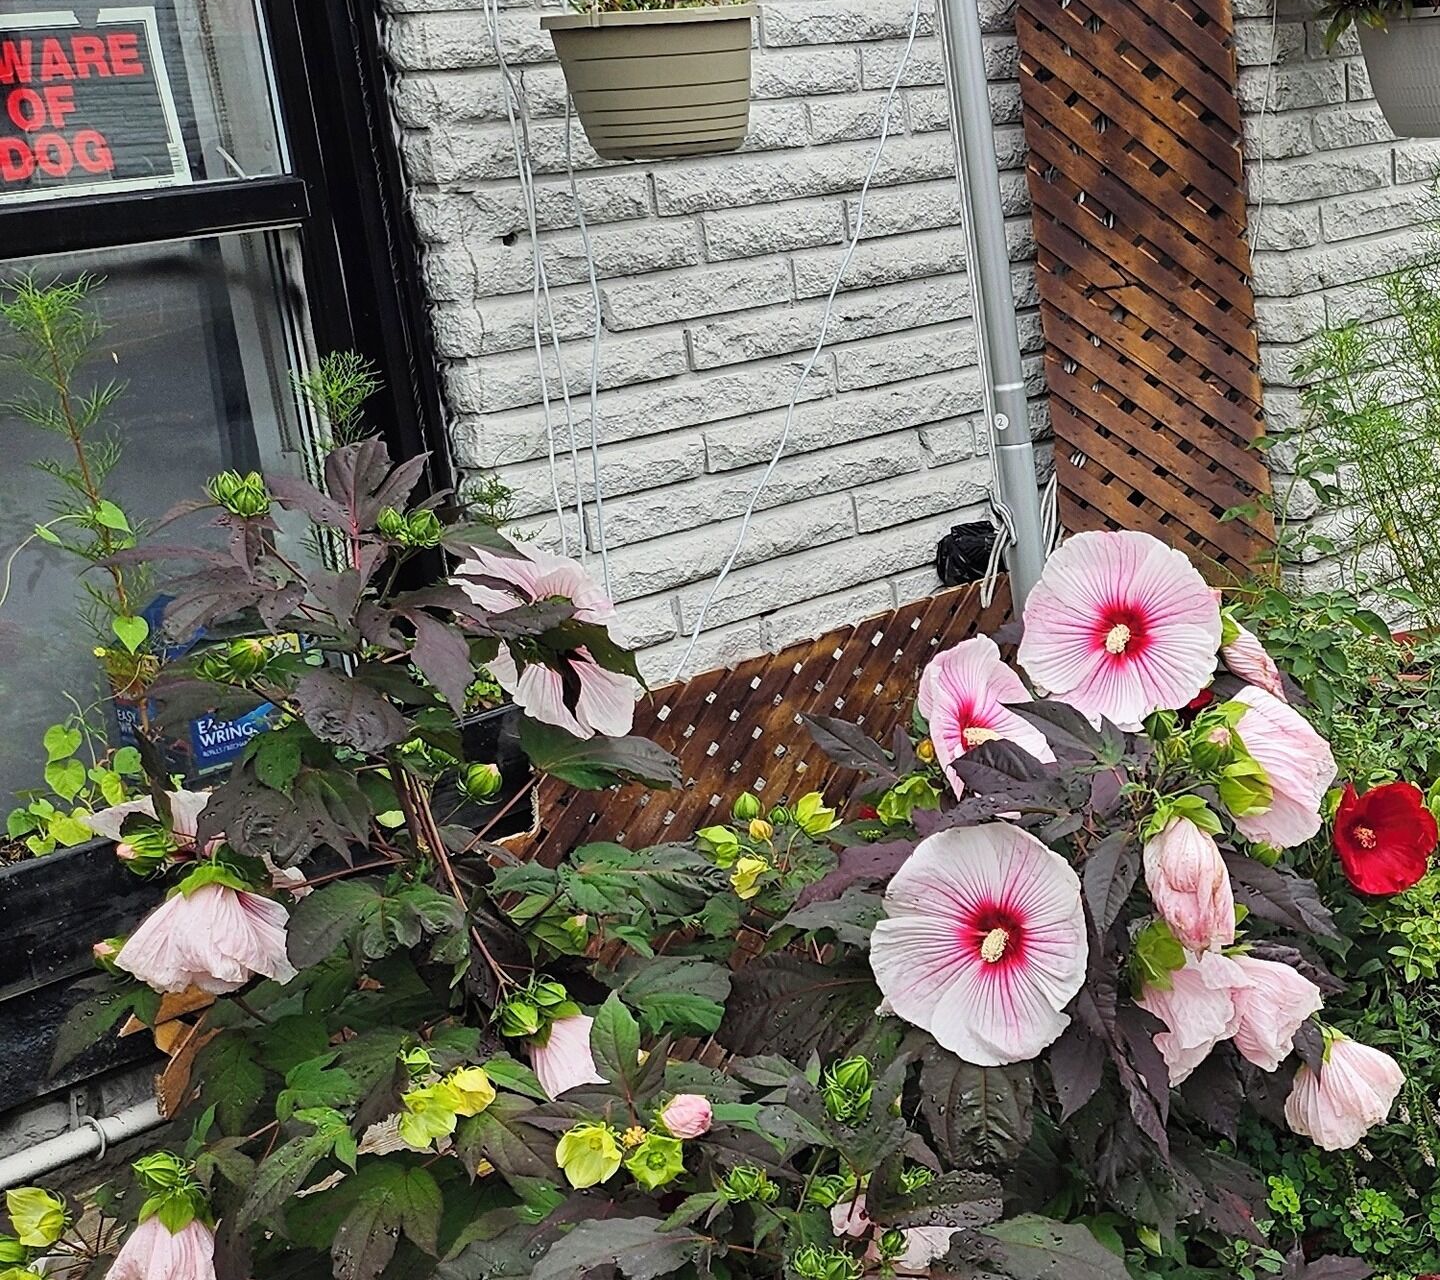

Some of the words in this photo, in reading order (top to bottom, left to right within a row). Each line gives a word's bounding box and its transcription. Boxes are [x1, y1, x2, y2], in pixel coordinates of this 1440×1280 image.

[6, 84, 76, 132] OF
[0, 130, 115, 182] DOG
[996, 417, 1004, 427] 2
[197, 719, 234, 734] EAS
[199, 722, 254, 747] WRING
